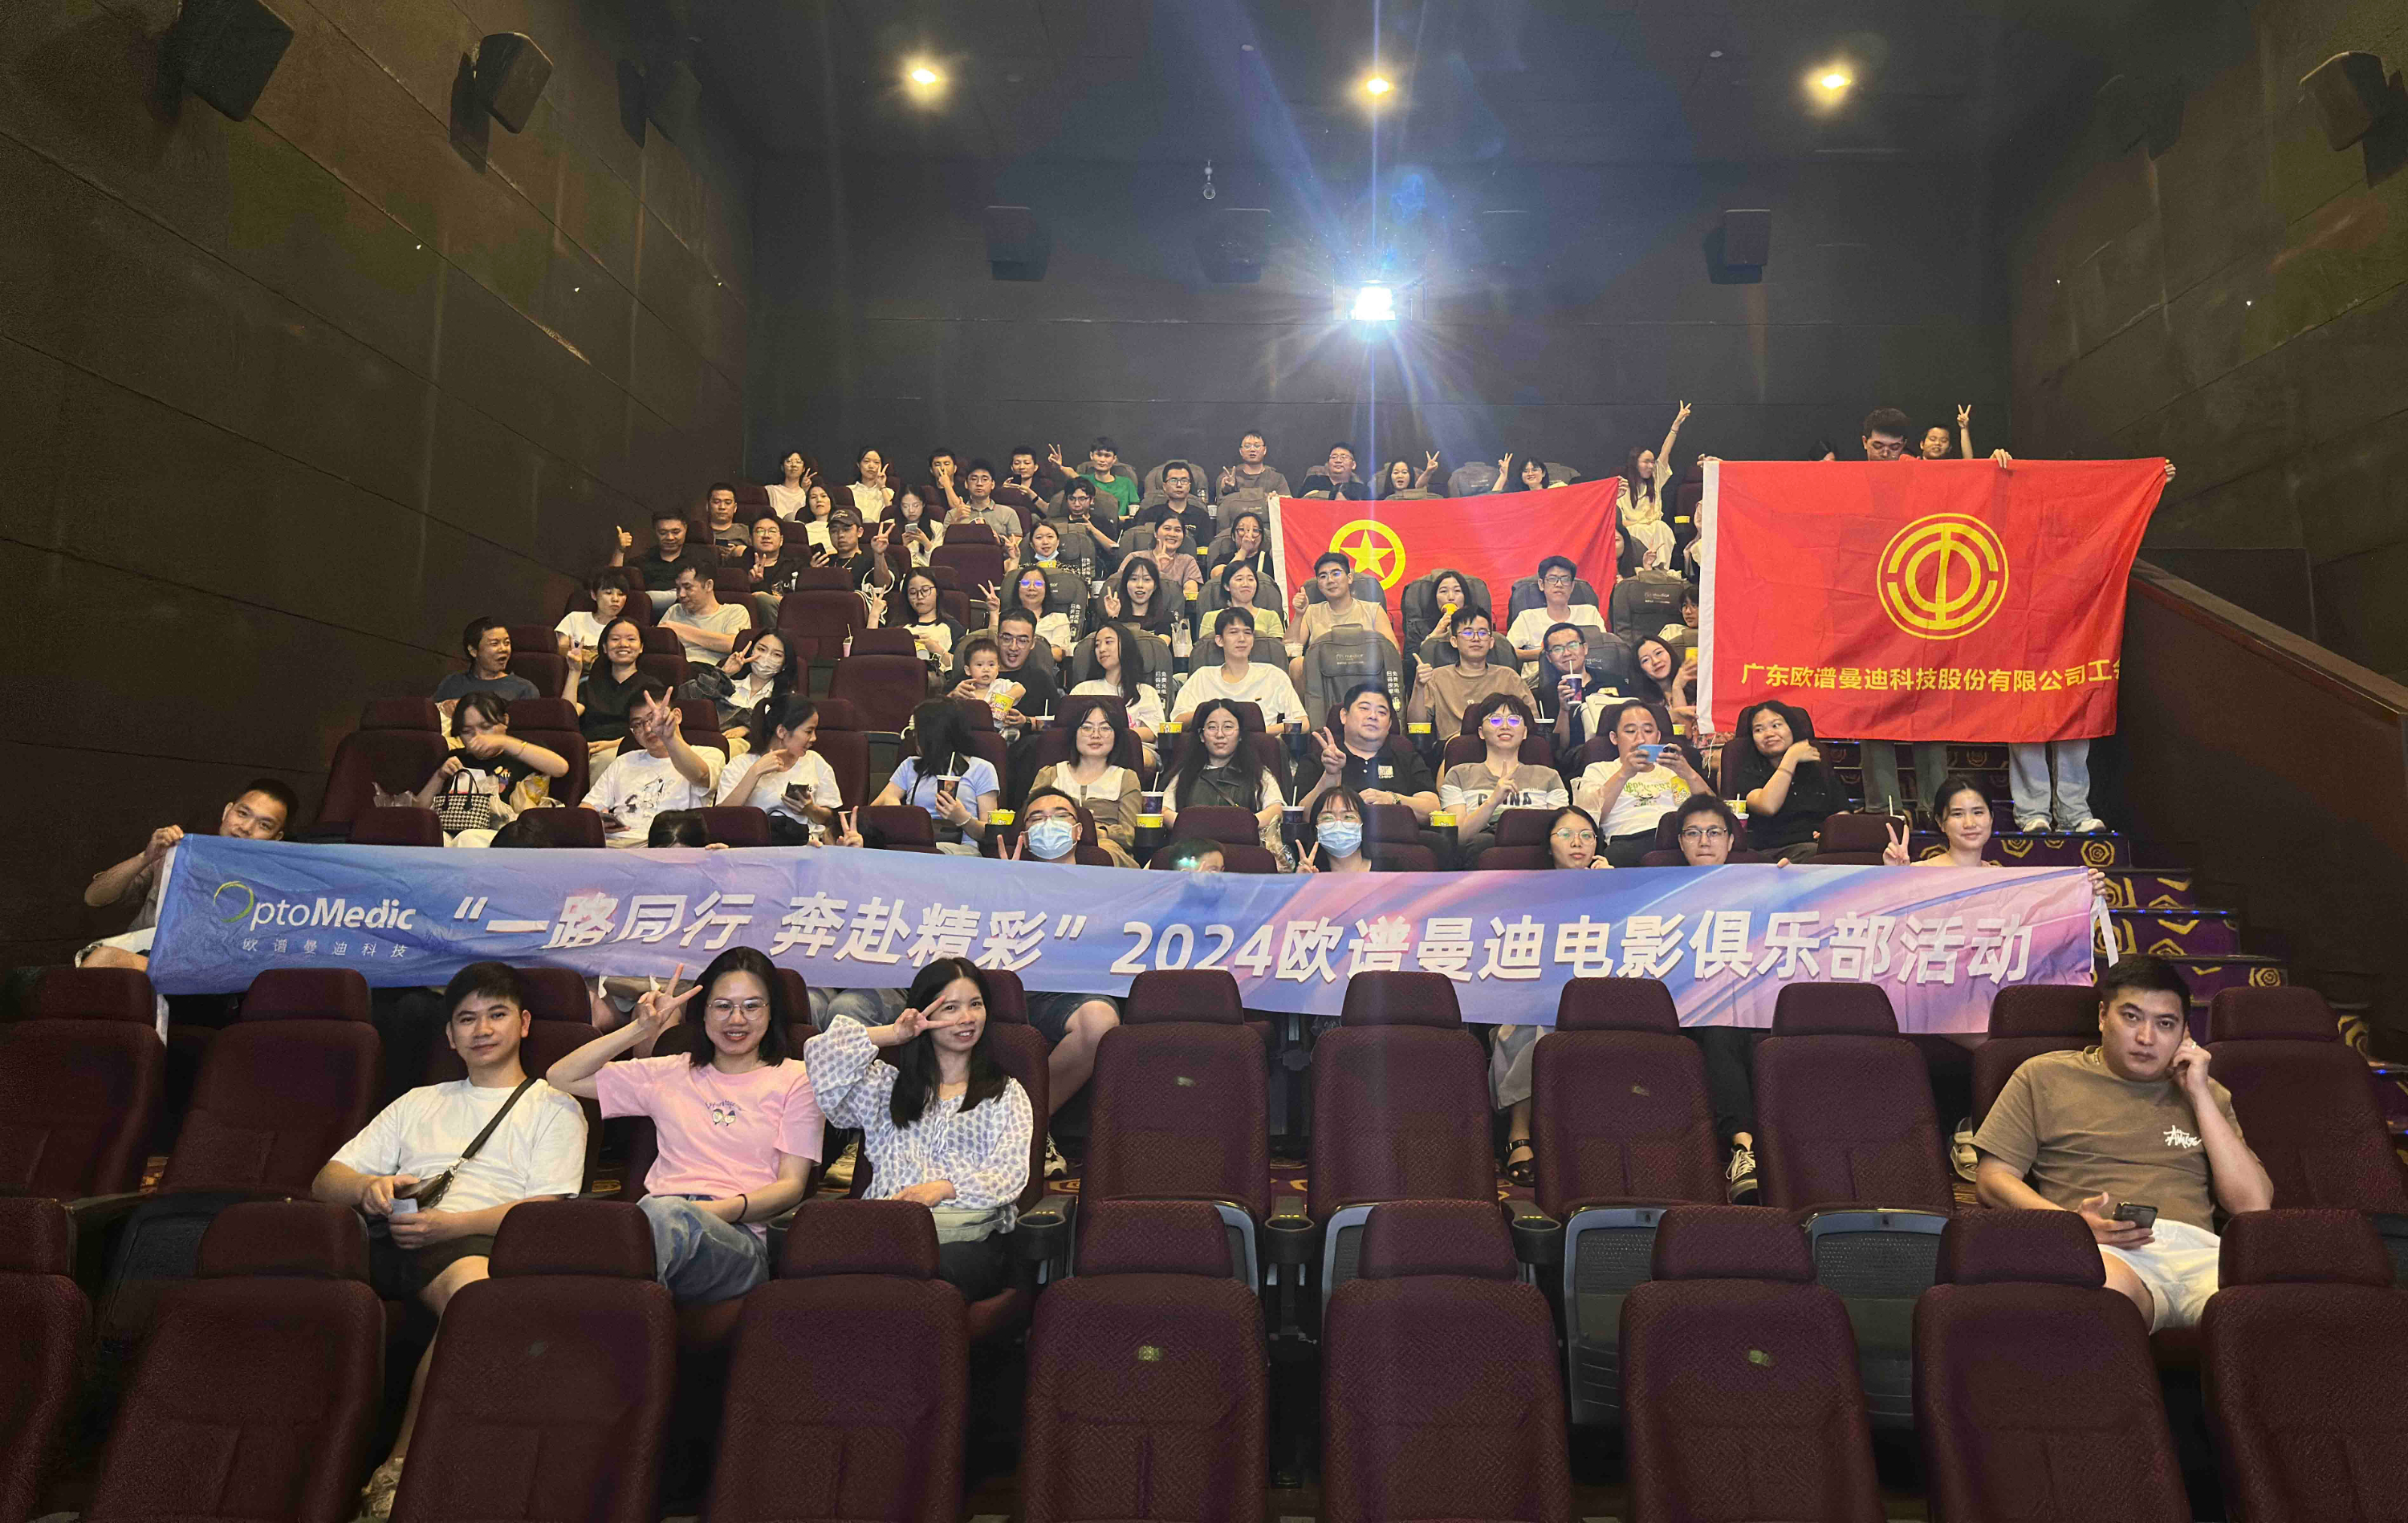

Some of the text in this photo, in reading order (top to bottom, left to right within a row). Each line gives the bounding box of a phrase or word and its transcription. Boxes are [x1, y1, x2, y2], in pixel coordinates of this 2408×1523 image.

[1478, 792, 1532, 806] CNA
[214, 880, 417, 932] OptoMedic
[242, 938, 408, 958] 欧谱曼迪科技
[1109, 909, 2033, 985] 2024欧谱曼迪电影俱乐部活动
